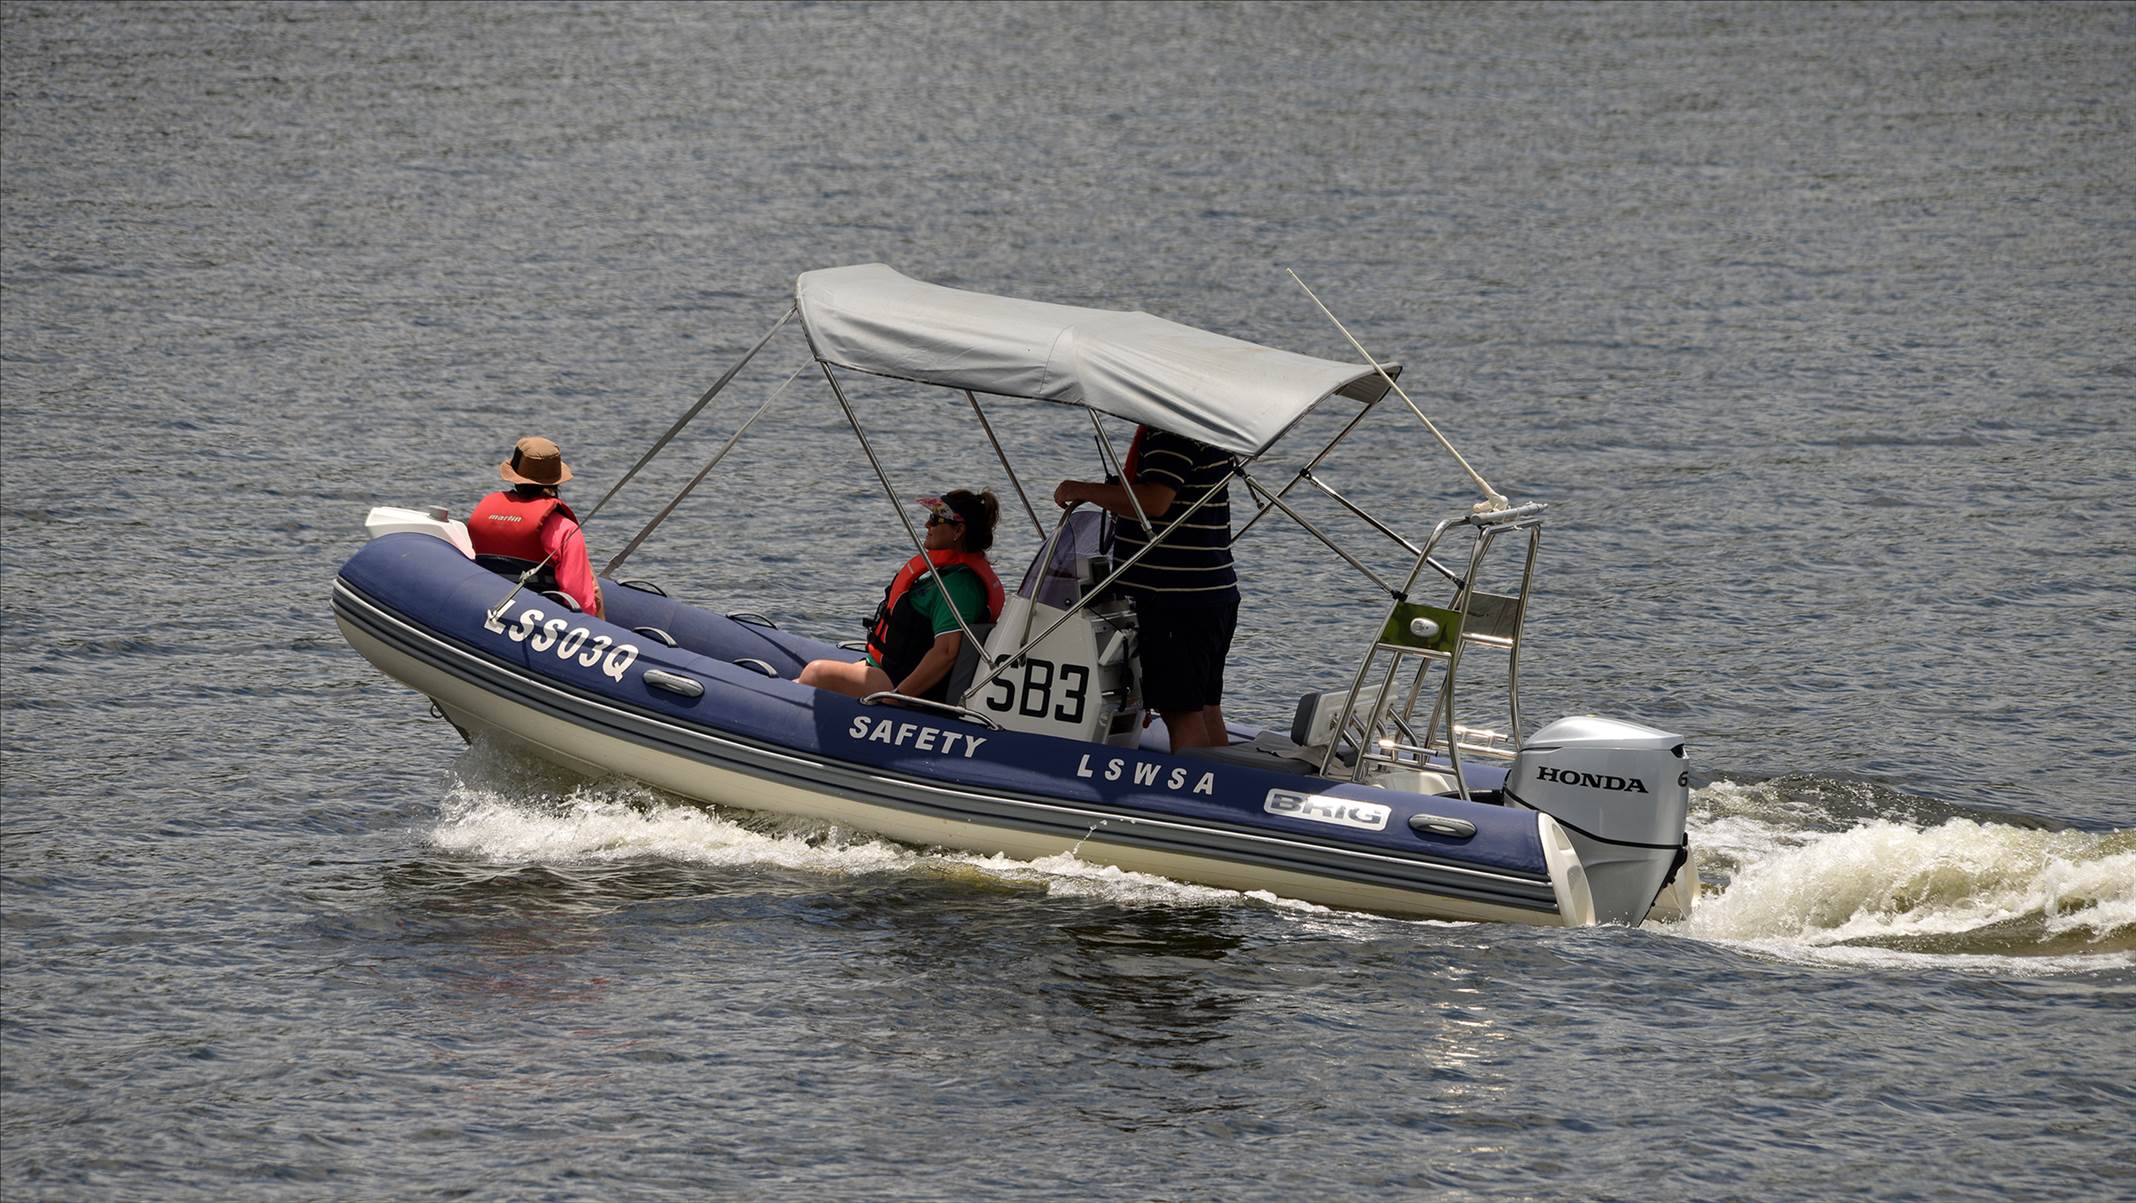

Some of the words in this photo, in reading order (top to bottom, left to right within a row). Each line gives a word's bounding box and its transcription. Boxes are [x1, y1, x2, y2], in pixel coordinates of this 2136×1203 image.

[488, 514, 522, 522] marlin
[484, 599, 639, 683] LSS03Q
[986, 654, 1090, 724] SB3
[849, 715, 988, 758] SAFETY
[1536, 765, 1649, 794] HONDA
